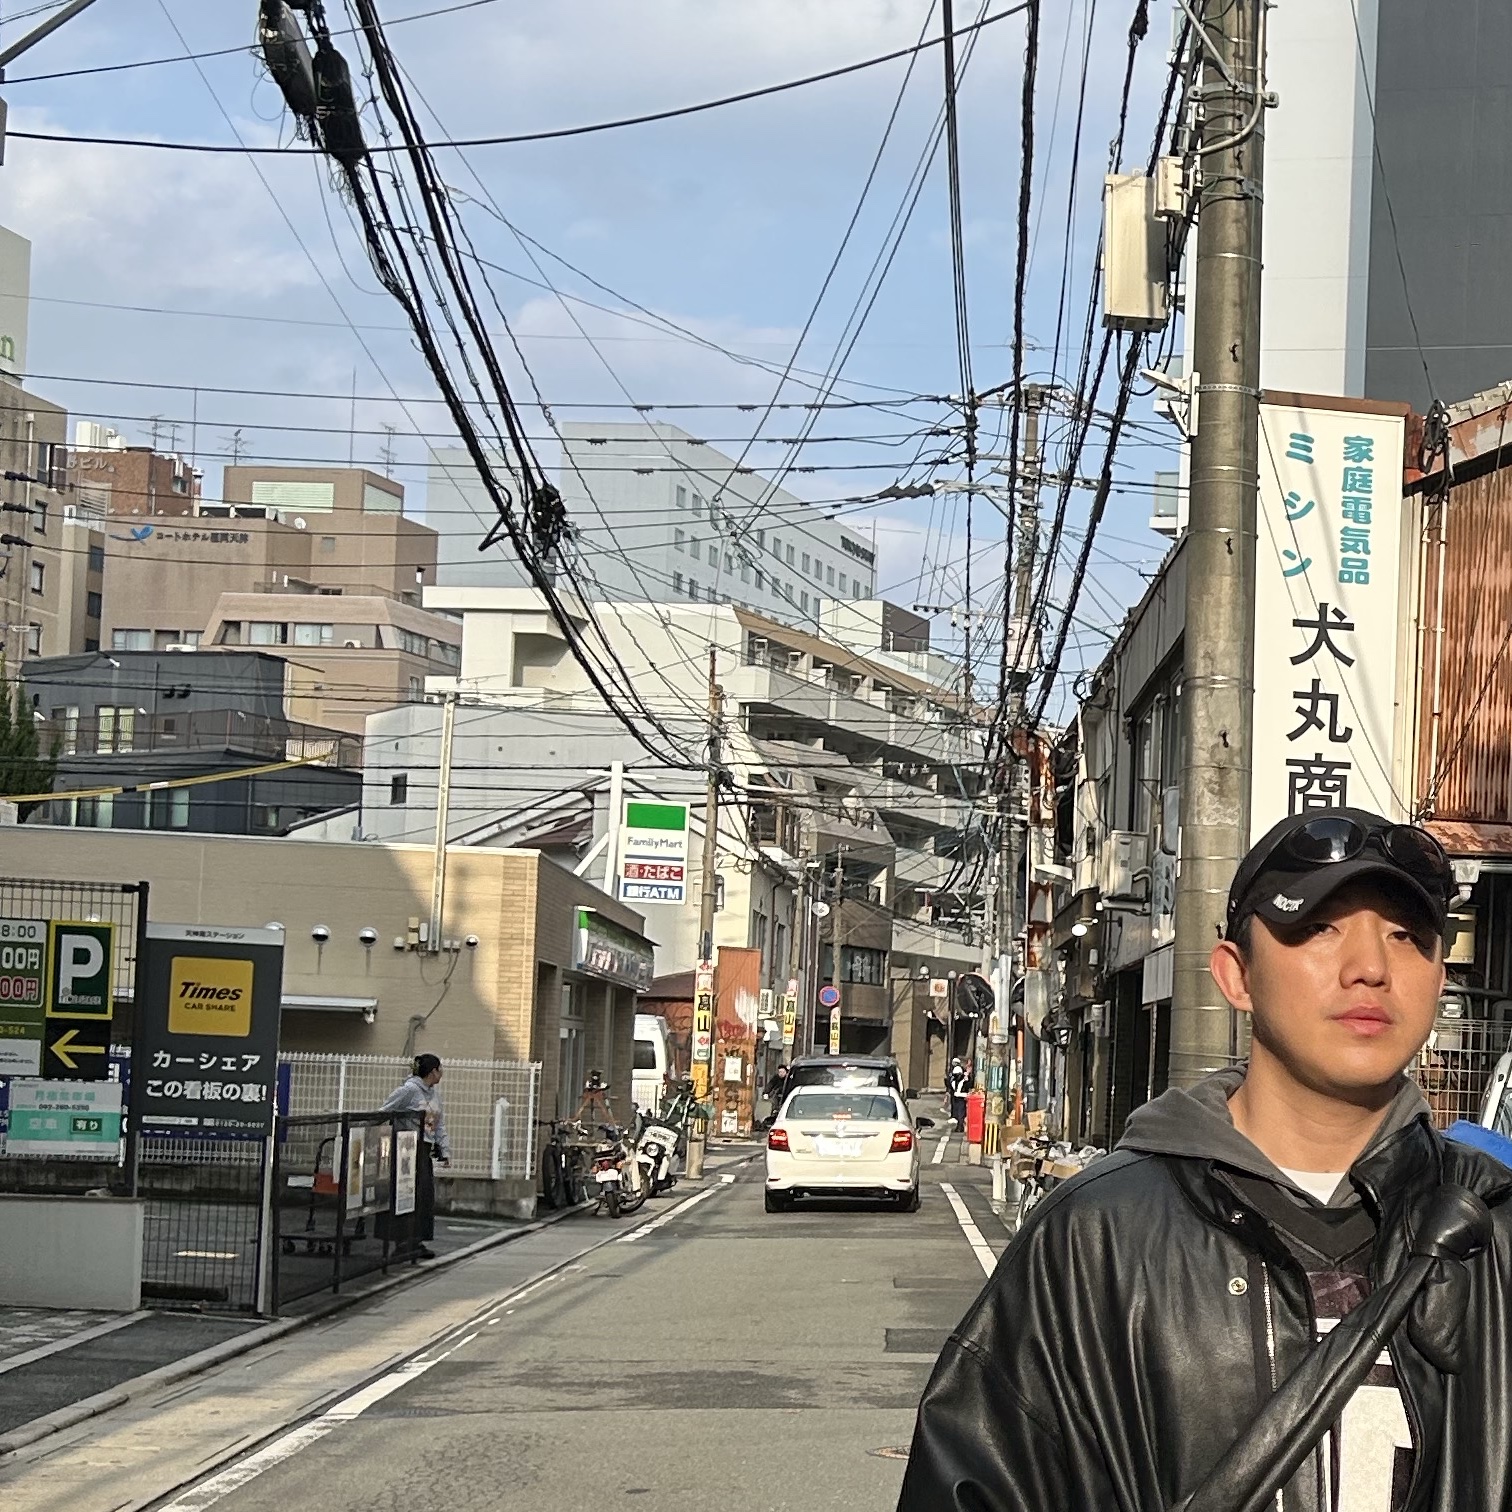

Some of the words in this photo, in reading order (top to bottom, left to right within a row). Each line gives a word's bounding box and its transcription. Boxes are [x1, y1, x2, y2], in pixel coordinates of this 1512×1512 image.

[1281, 432, 1315, 578] ミシン
[1338, 435, 1375, 586] 家庭電気品
[627, 836, 683, 849] FamilyMart
[626, 885, 680, 900] 銀行ATM
[58, 933, 104, 1004] P
[179, 981, 243, 1001] Times
[184, 1003, 203, 1011] CAR
[205, 1004, 237, 1012] SHARE
[152, 1050, 261, 1071] カーシェア
